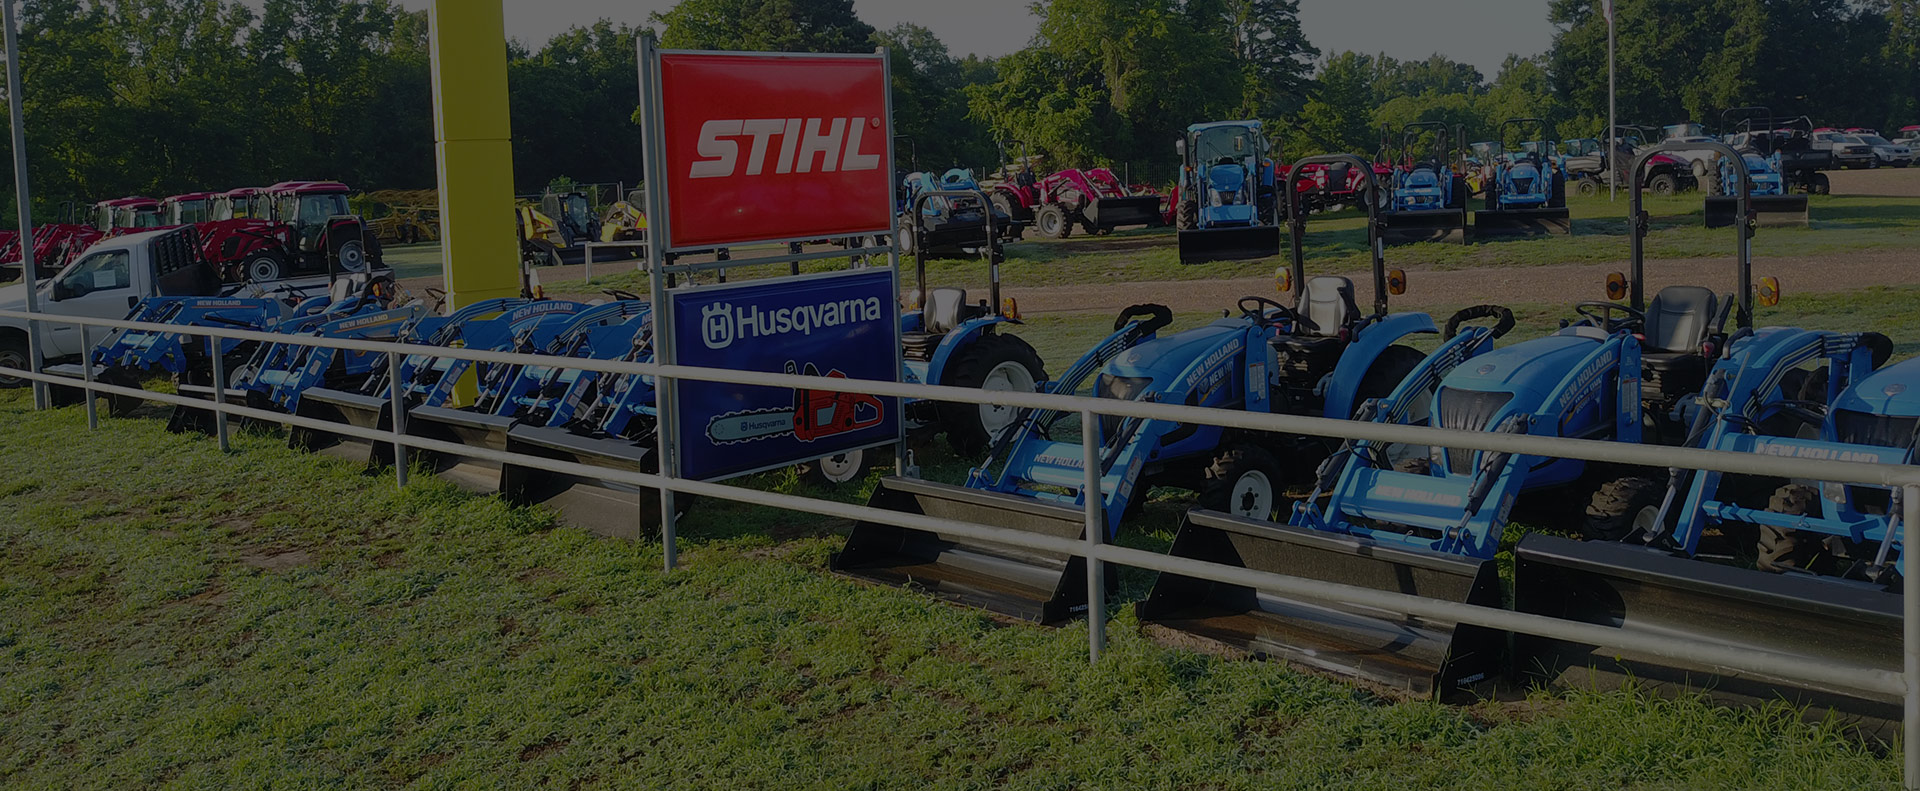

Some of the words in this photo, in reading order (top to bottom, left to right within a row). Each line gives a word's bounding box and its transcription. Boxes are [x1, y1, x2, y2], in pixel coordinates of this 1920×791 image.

[512, 307, 533, 320] NEW
[532, 302, 573, 312] HOLLAND
[736, 296, 881, 339] Husqvarna
[339, 320, 356, 329] NEW
[356, 313, 388, 326] HOLLAND
[1186, 364, 1205, 386] NEW
[1204, 338, 1239, 369] HOLLAND
[1559, 380, 1579, 408] NEW
[1577, 350, 1612, 386] HOLLAND
[749, 419, 786, 430] Husqvarna
[1034, 454, 1057, 465] NEW
[1055, 456, 1084, 469] HOLLA
[1755, 442, 1796, 457] NEW
[1797, 447, 1878, 463] HOLLAND
